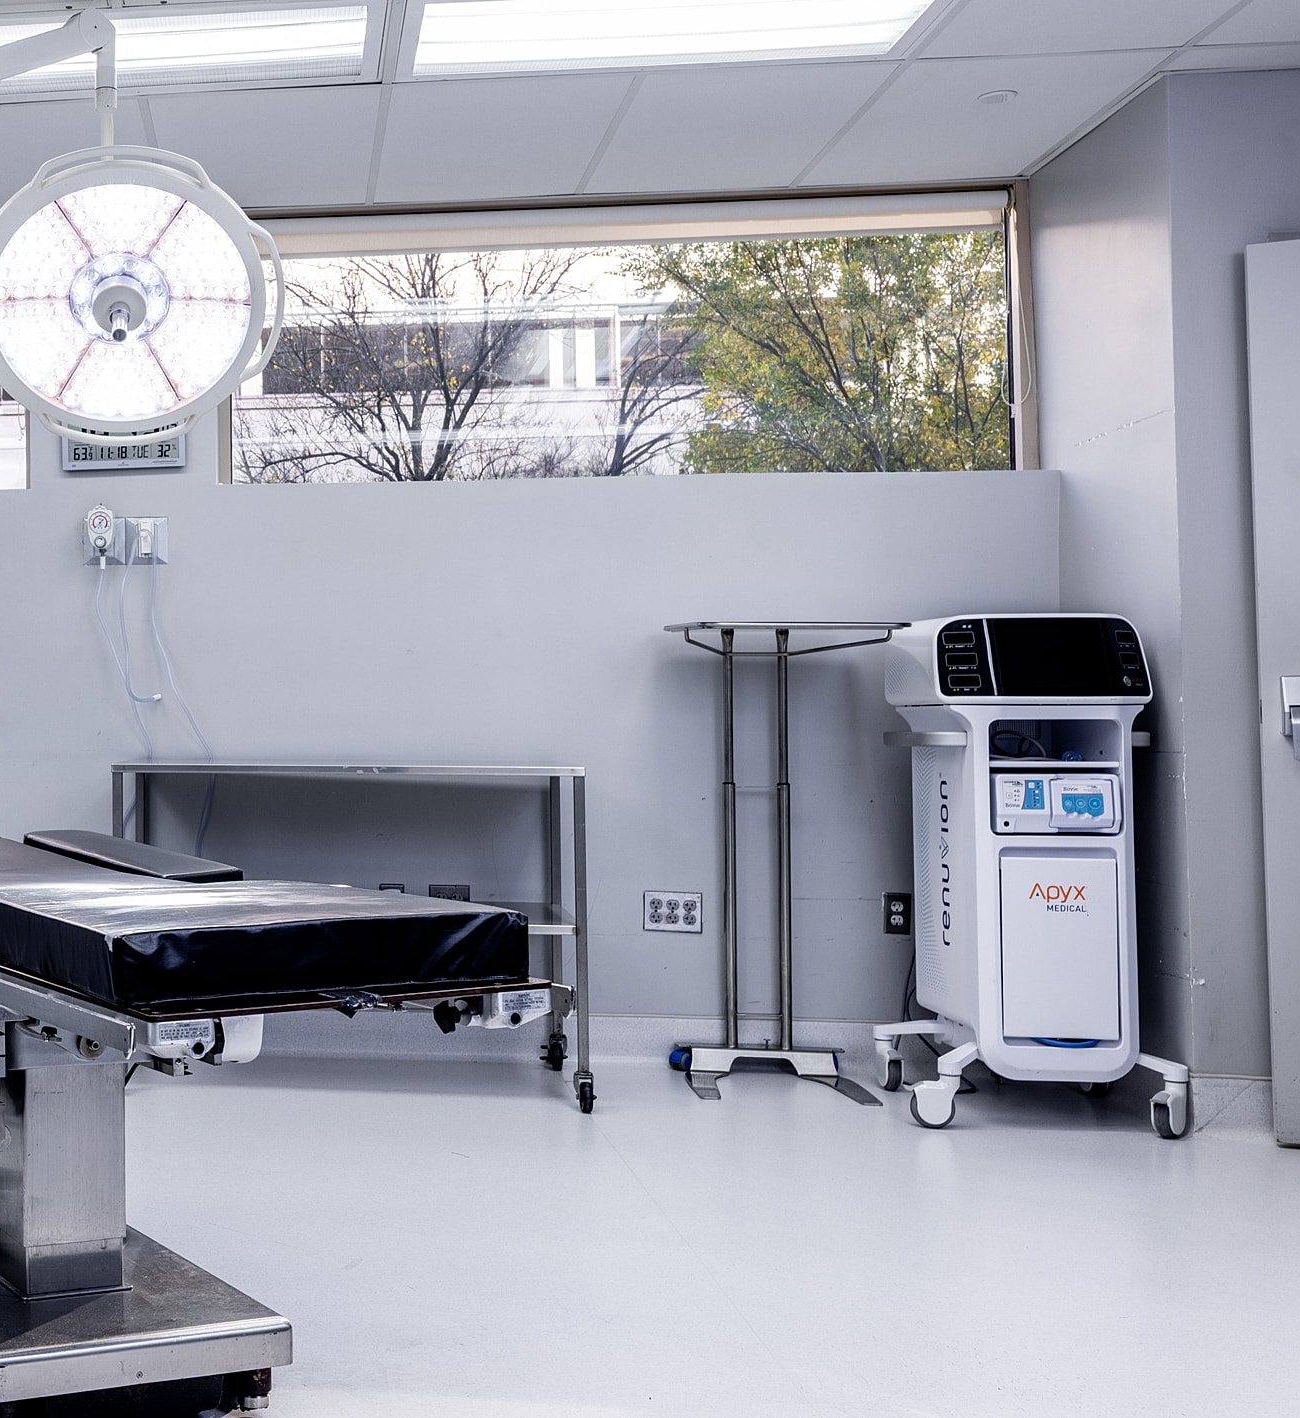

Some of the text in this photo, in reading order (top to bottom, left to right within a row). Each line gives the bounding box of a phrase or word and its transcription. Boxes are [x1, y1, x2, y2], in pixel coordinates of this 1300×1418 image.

[132, 445, 148, 458] TUE
[157, 444, 170, 457] 32
[939, 780, 951, 946] renuvion
[1029, 883, 1085, 903] Apyx
[1046, 904, 1087, 912] MEDICAL
